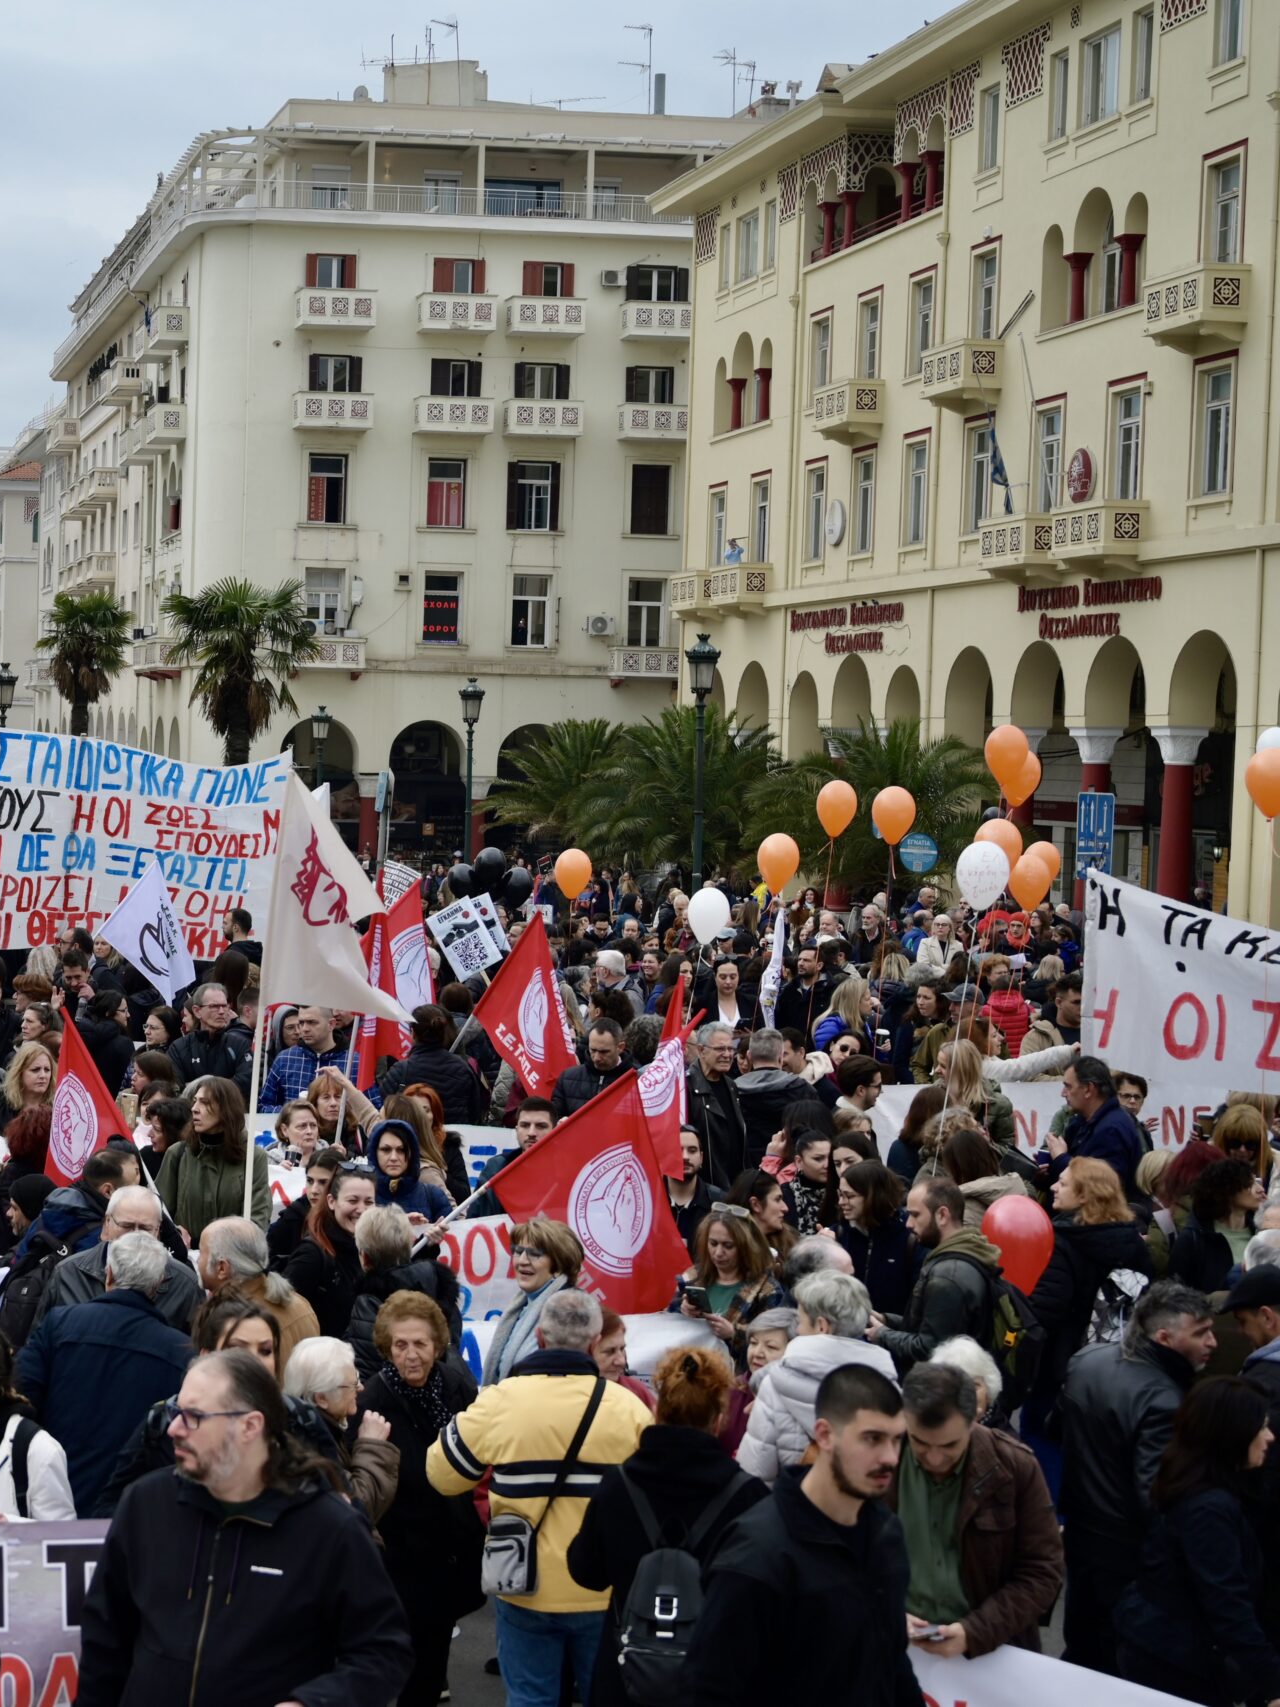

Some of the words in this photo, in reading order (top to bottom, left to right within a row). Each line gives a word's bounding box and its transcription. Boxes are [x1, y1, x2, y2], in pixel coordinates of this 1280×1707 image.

[17, 834, 56, 872] ΔΕ
[62, 832, 96, 871] ΘΑ
[1160, 904, 1212, 950] ΤΑ
[1163, 992, 1227, 1061] ΟΙ
[584, 1236, 602, 1257] 1900
